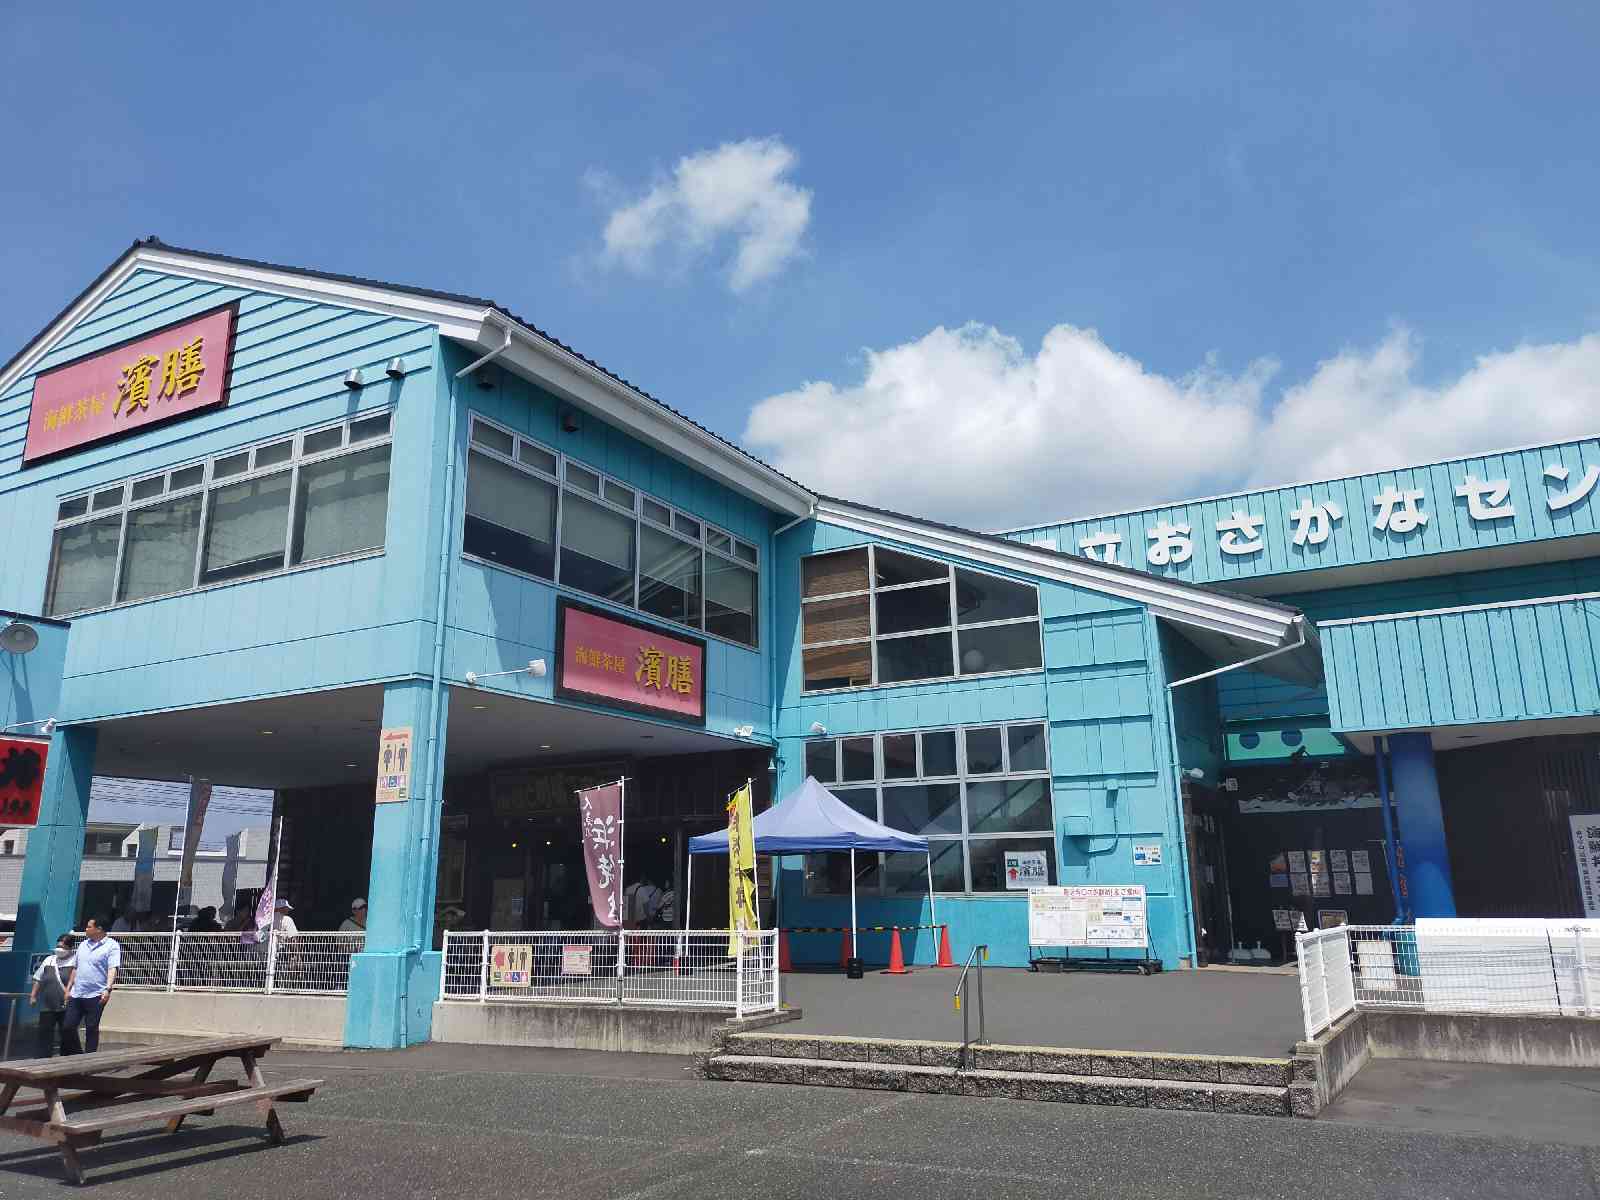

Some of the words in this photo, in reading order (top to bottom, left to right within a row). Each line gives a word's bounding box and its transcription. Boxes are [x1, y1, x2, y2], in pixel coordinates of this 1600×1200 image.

[1030, 464, 1600, 566] 立おさかなセン
[634, 646, 694, 694] 濱膳
